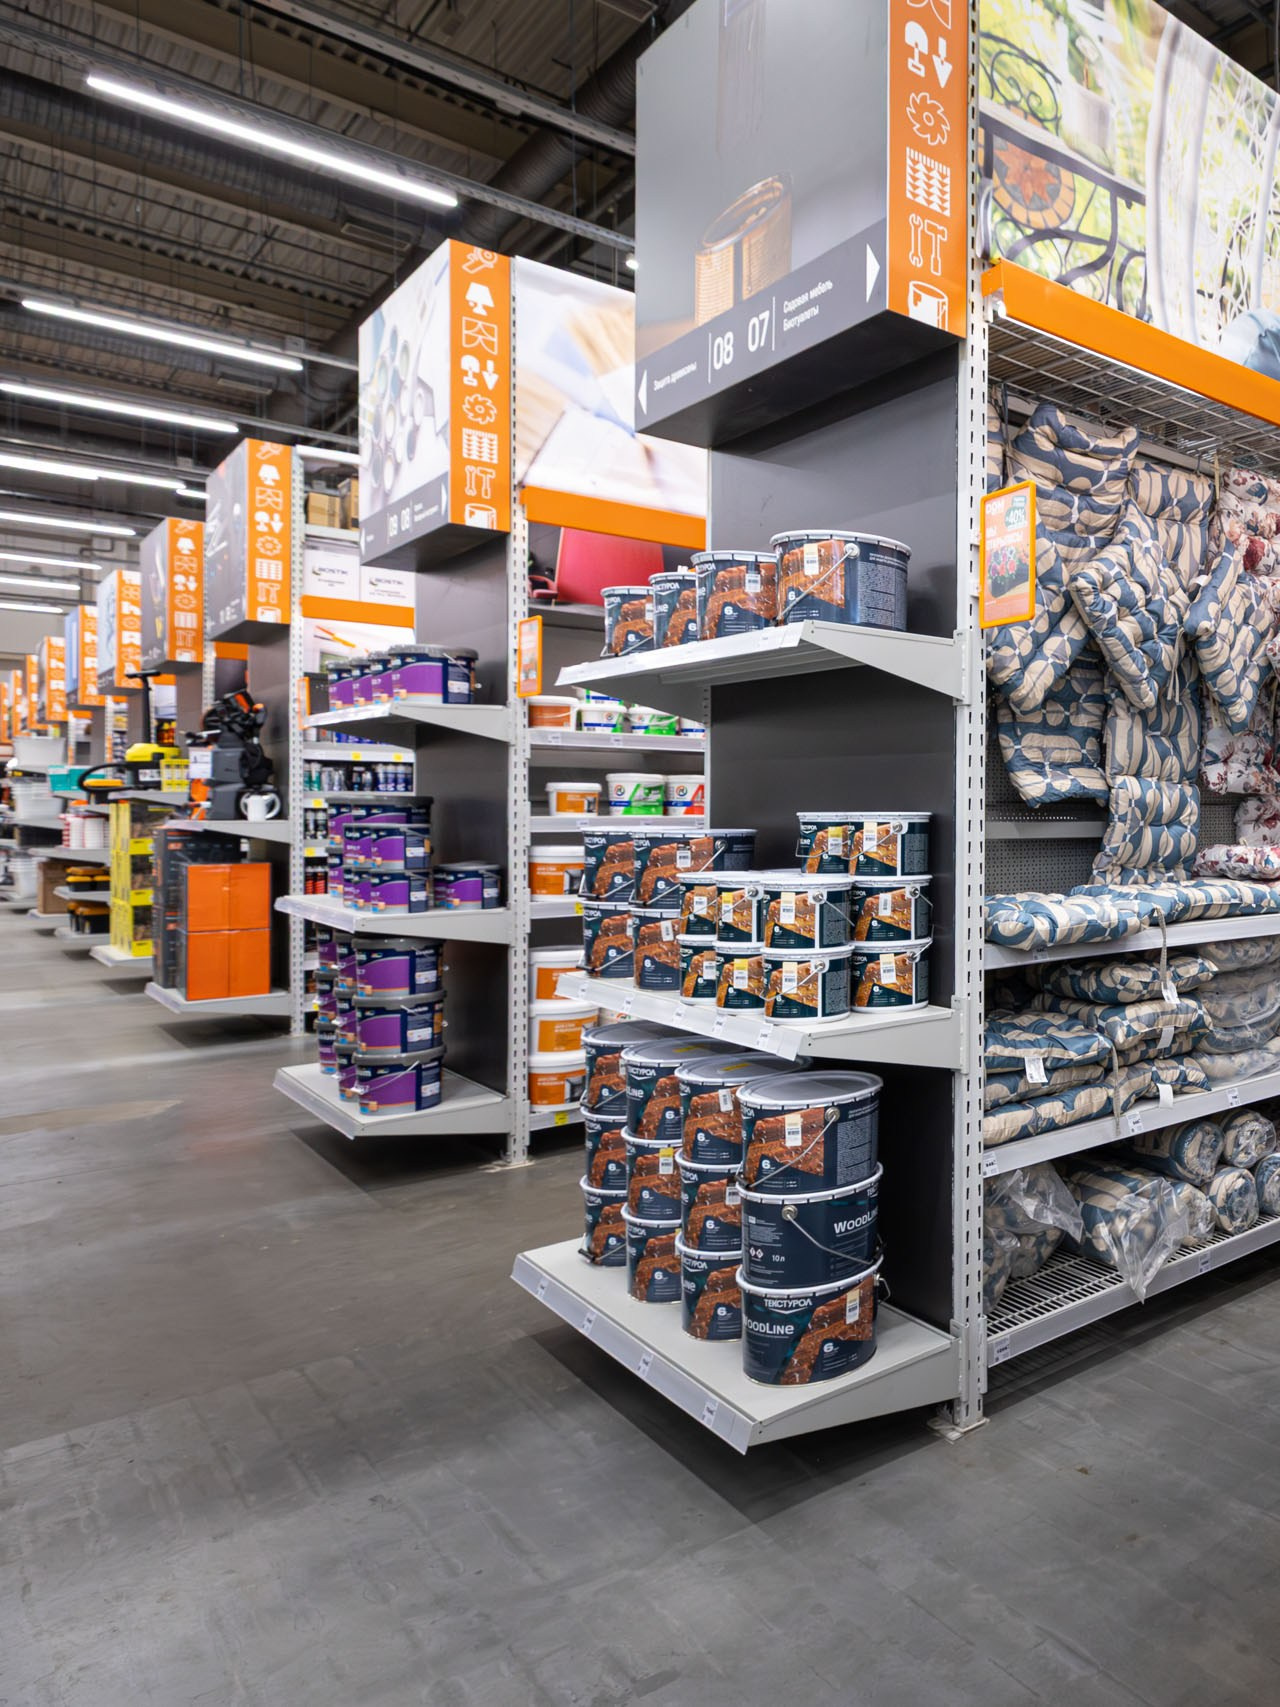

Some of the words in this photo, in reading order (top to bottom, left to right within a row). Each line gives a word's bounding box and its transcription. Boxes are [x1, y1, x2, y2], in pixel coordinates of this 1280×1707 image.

[713, 331, 734, 370] 08
[747, 310, 770, 352] 07
[764, 1298, 812, 1308] ТЕКСТУРОЛ
